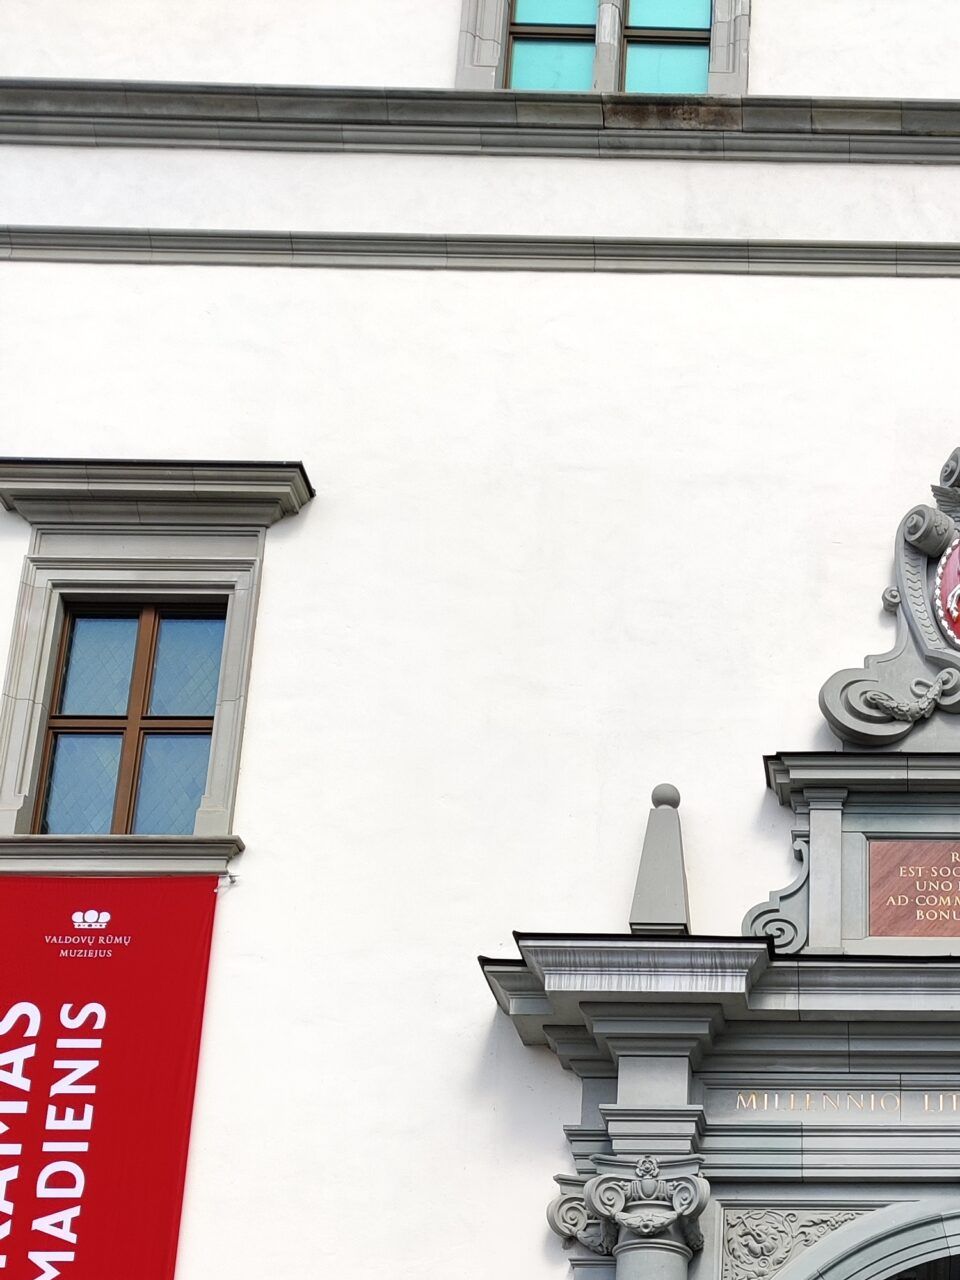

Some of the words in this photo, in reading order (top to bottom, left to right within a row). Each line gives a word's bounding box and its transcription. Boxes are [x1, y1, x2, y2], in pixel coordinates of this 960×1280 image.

[900, 866, 925, 877] EST
[916, 881, 952, 892] UNO
[44, 935, 96, 946] VALDOVŲ
[59, 949, 113, 958] MUZIEJUS
